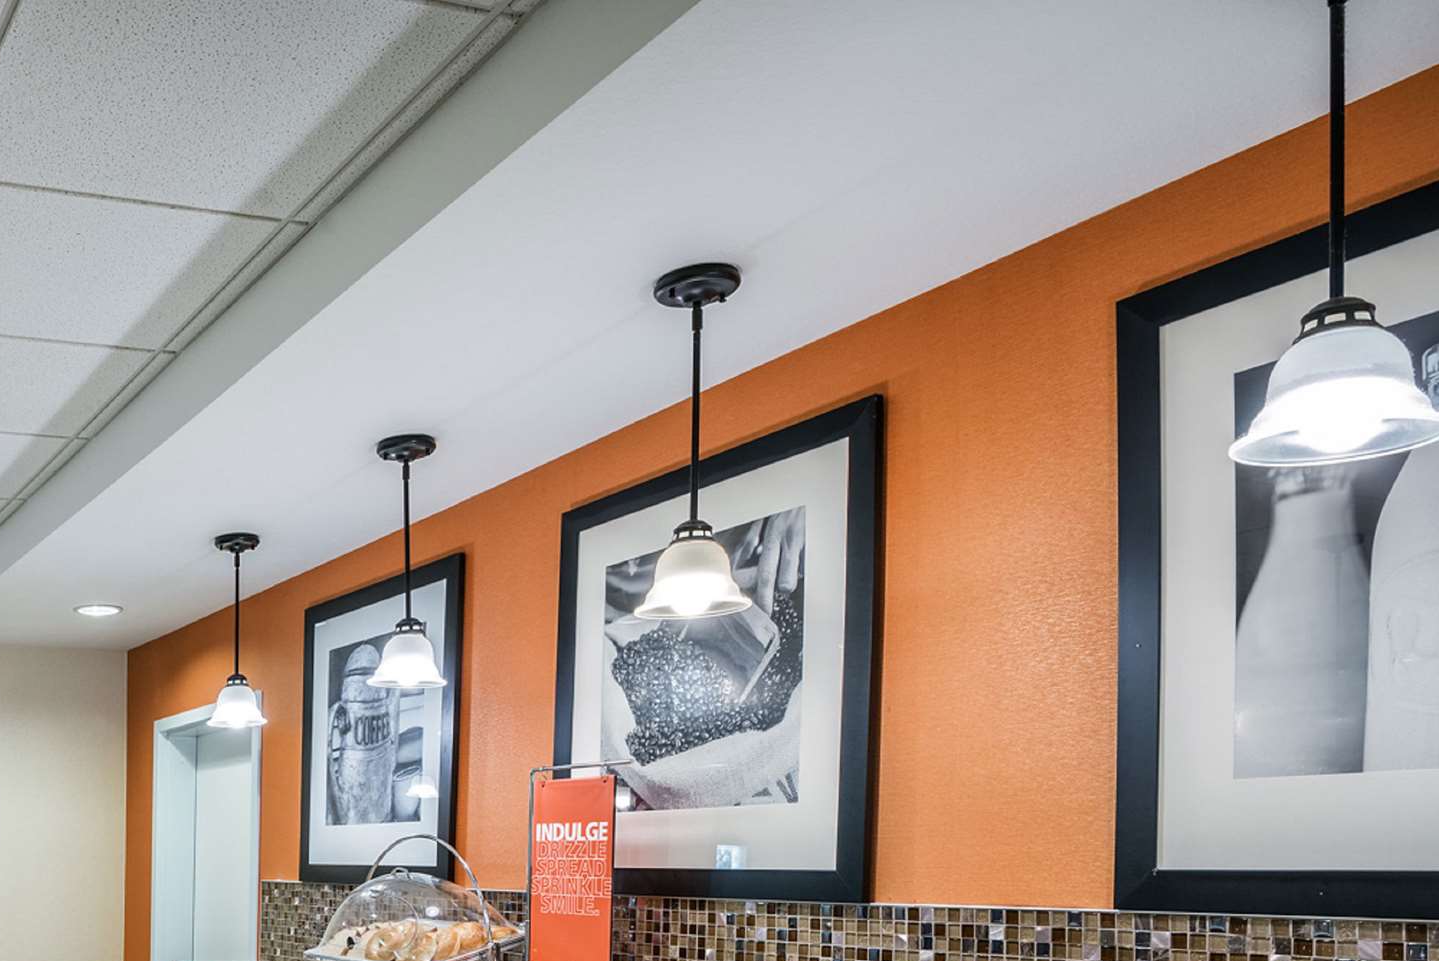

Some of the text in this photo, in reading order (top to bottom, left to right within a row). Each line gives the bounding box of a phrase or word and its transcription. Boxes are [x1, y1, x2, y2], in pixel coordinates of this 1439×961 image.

[536, 822, 608, 841] INDULGE
[536, 839, 608, 859] DRIZZLE
[536, 857, 607, 878] SPREAD
[531, 875, 612, 897] SPRINKLE
[540, 893, 601, 916] SMILE.
